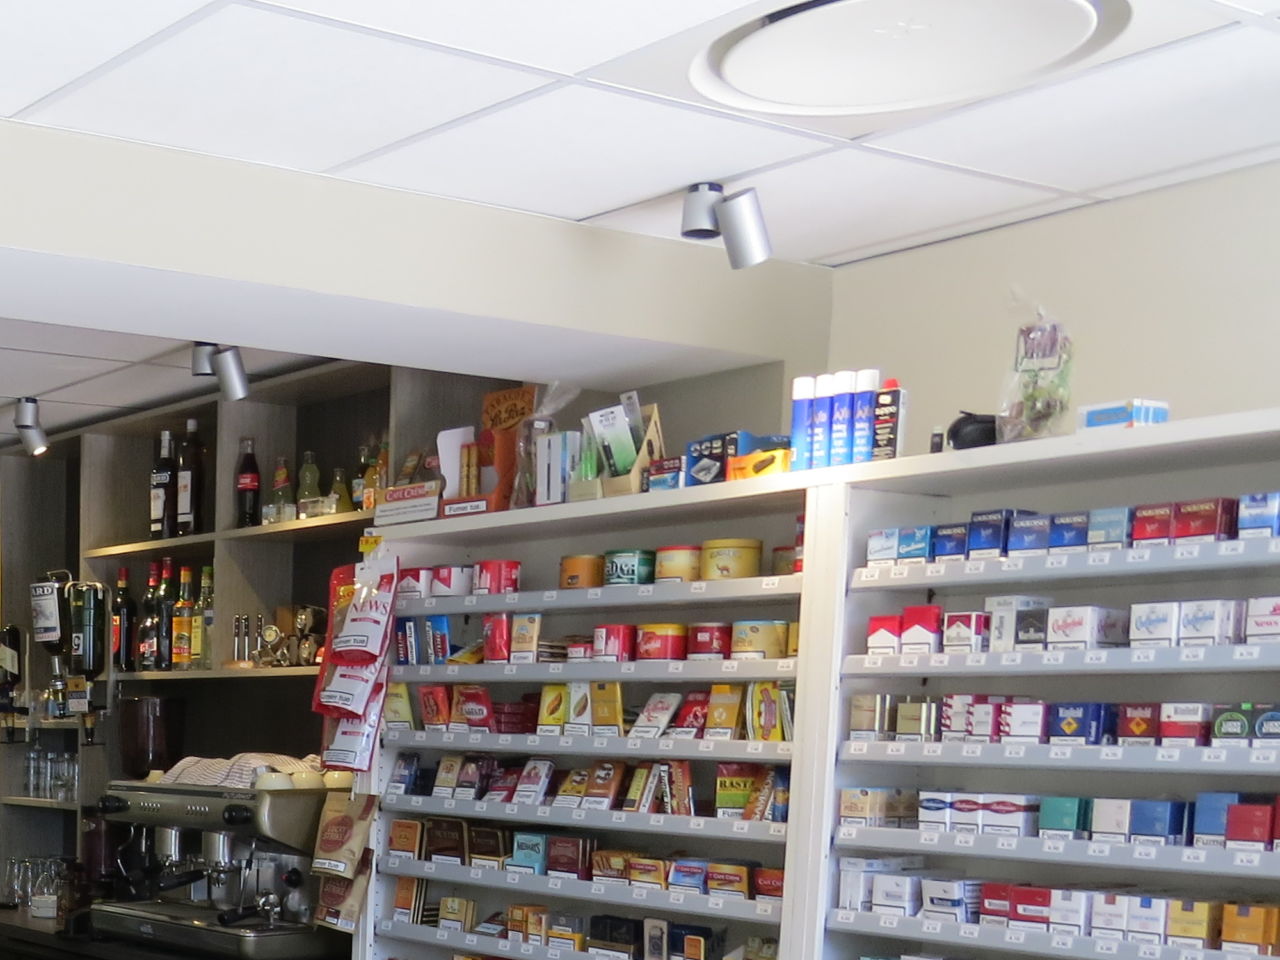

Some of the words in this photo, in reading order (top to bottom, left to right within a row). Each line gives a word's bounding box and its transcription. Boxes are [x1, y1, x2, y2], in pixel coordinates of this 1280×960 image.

[448, 505, 468, 513] Fumer
[350, 600, 388, 615] NEWS
[722, 810, 744, 818] Fum
